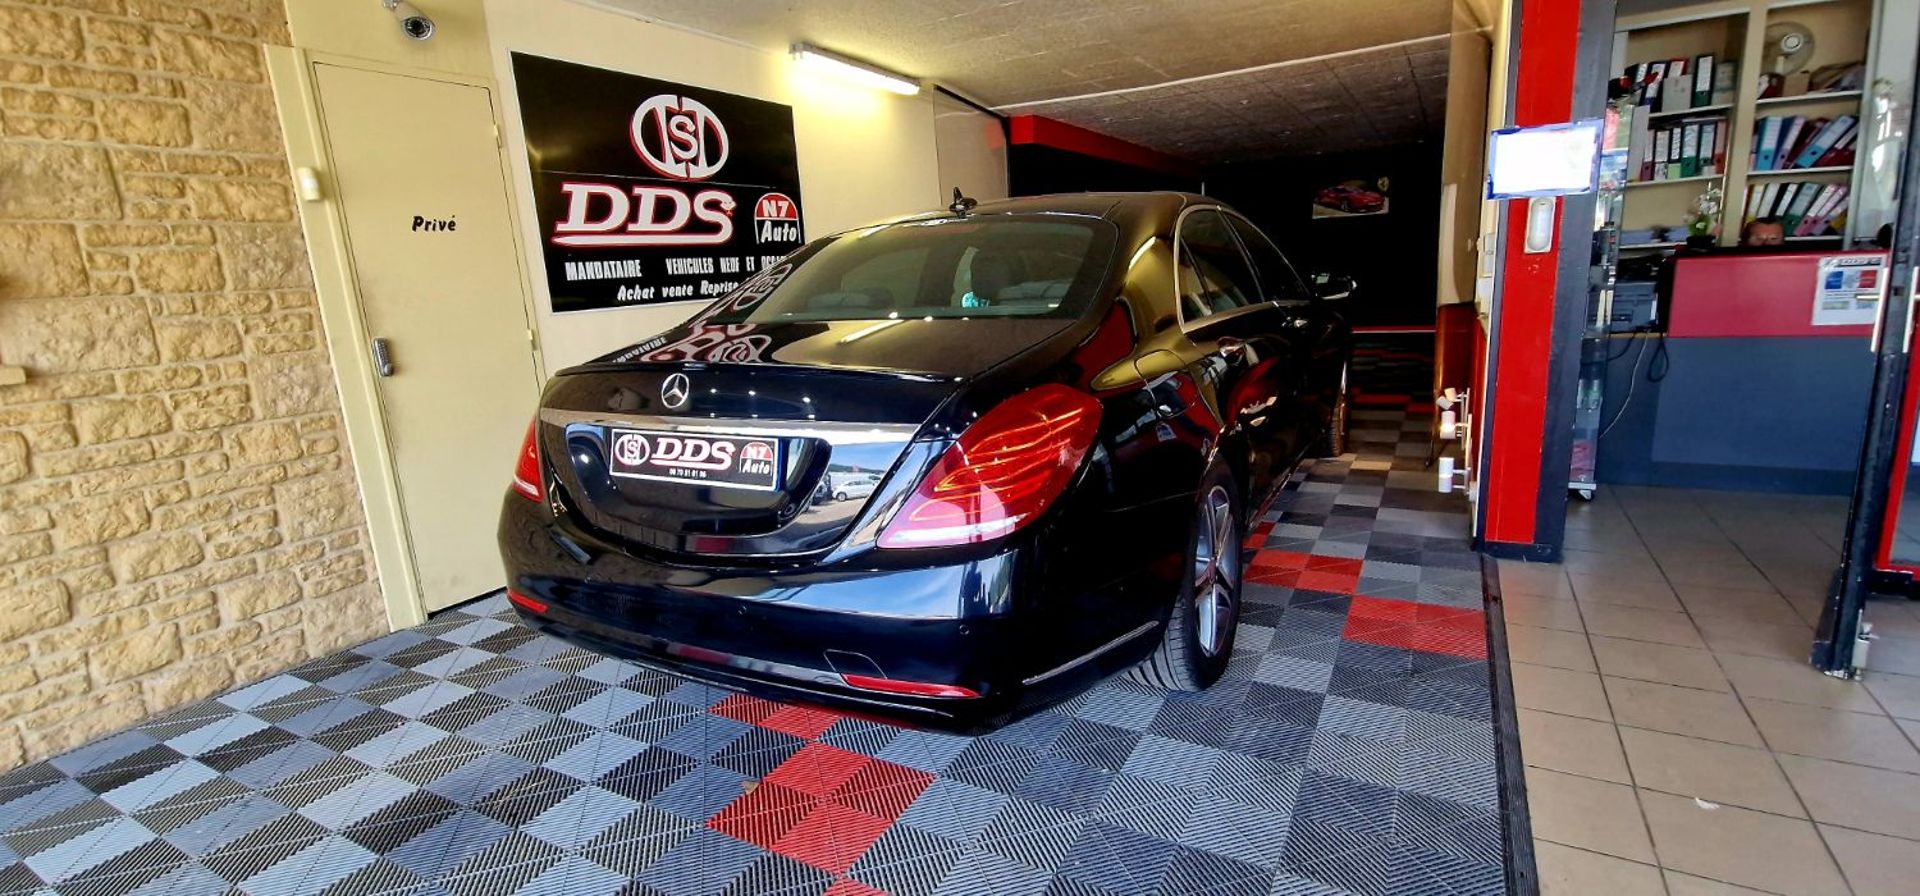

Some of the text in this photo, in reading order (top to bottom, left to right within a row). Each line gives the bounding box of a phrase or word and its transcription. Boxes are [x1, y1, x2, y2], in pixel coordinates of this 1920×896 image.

[551, 183, 736, 247] DDS
[762, 200, 789, 217] N7
[411, 215, 457, 234] Privé
[760, 222, 798, 243] Auto
[565, 260, 642, 281] MANDATAIRE
[665, 256, 714, 276] VEHICULES
[720, 257, 740, 274] NEUF
[746, 256, 755, 272] ET
[617, 279, 738, 302] Achat vente Reprise
[650, 437, 736, 470] DDS
[742, 460, 771, 475] Auto
